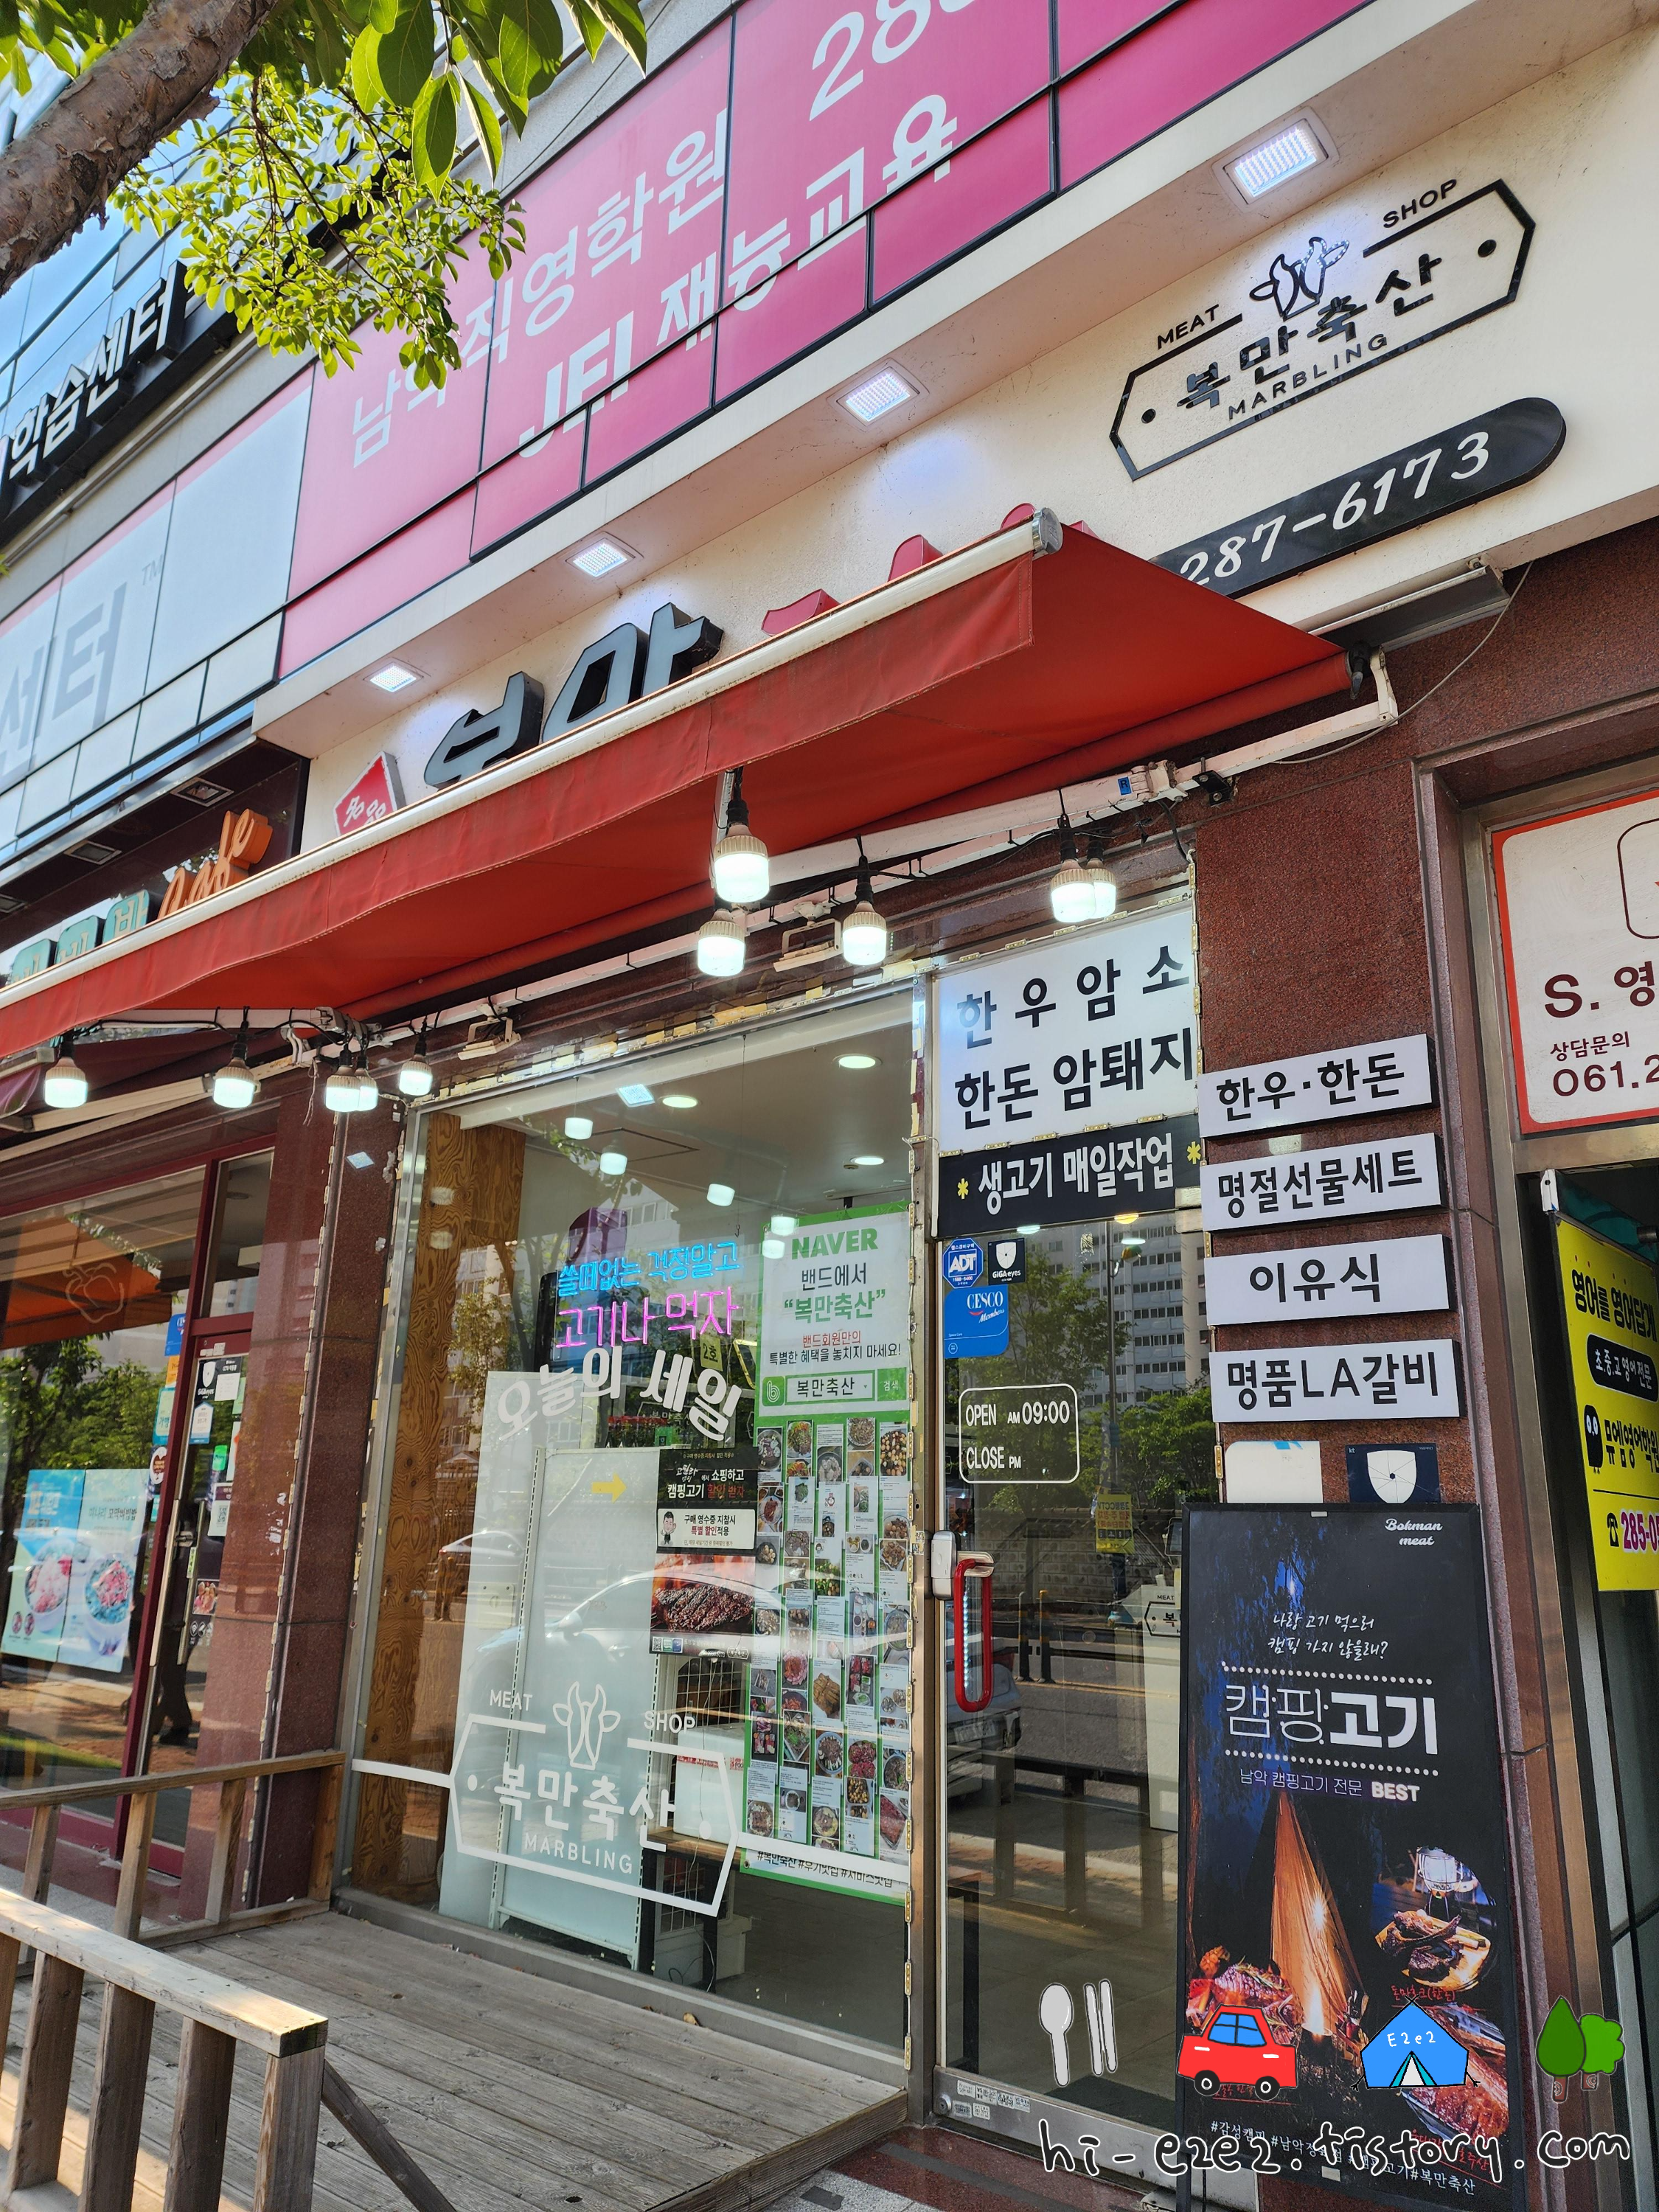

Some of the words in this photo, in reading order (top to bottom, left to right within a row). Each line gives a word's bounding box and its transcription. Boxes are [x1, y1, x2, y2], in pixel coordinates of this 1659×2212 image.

[809, 0, 976, 121] 28
[655, 94, 958, 351] 재능교육
[1157, 304, 1220, 349] MEAT
[1382, 178, 1458, 229] SHOP
[1176, 252, 1442, 408] 복만축산
[0, 260, 178, 481] 학습센터
[1228, 333, 1389, 420] MARBLING
[1180, 431, 1490, 587] 287-6173
[1549, 1031, 1630, 1062] 상담문의
[954, 1063, 1039, 1130] 한돈
[1053, 1028, 1193, 1112] 암퇘지
[978, 1152, 1053, 1215] 생고기
[1063, 1133, 1174, 1197] 매일작업
[1218, 1150, 1422, 1219] 명절선물세트
[791, 1228, 878, 1260] NAVER
[801, 1262, 867, 1291] 밴드에서
[949, 1253, 977, 1273] ADT
[1249, 1253, 1380, 1303] 이유식
[967, 1291, 1004, 1310] CESCO
[978, 1308, 1005, 1324] Members
[1571, 1268, 1611, 1323] 영어를
[1610, 1285, 1658, 1343] 영어답게
[556, 1297, 655, 1348] 고기나
[666, 1287, 740, 1340] 먹자
[769, 1350, 798, 1366] 특별한
[801, 1348, 830, 1363] 혜택을
[832, 1346, 863, 1362] 놓치지
[866, 1343, 901, 1358] 마세요!
[802, 1330, 861, 1348] 밴드회원만의
[497, 1346, 622, 1440] 오늘의
[639, 1349, 742, 1441] 세일
[797, 1377, 855, 1398] 복만축산
[883, 1381, 900, 1392] 검색
[1227, 1352, 1438, 1411] 명품LA갈비
[965, 1404, 997, 1427] OPEN
[1007, 1411, 1020, 1424] AM
[1022, 1400, 1070, 1425] 09:00
[966, 1446, 1005, 1470] CLOSE
[1009, 1455, 1021, 1469] PM
[667, 1484, 705, 1499] 캠핑고기
[707, 1484, 726, 1500] 할인
[711, 1469, 745, 1482] 쇼핑하고
[684, 1514, 696, 1524] 구매
[698, 1514, 716, 1525] 영수증
[717, 1514, 736, 1525] 지참시
[691, 1526, 703, 1535] 특별
[1384, 1518, 1444, 1531] Bokman
[1621, 1510, 1659, 1552] 285-0
[1399, 1535, 1435, 1546] meat
[1273, 1613, 1302, 1629] 나랑
[1305, 1614, 1329, 1628] 고기
[1335, 1615, 1374, 1632] 먹으러
[1267, 1637, 1300, 1655] 캠핑
[1306, 1639, 1333, 1654] 가지
[1338, 1638, 1389, 1661] 않을래?
[490, 1689, 533, 1711] MEAT
[644, 1711, 696, 1733] SHOP
[1239, 1768, 1267, 1787] 남악
[1272, 1770, 1329, 1793] 캠핑고기
[1333, 1777, 1363, 1796] 전문
[1371, 1781, 1420, 1802] BEST
[494, 1761, 676, 1852] 복만축산
[524, 1833, 633, 1874] MARBLING
[1410, 2168, 1476, 2196] #복만축산
